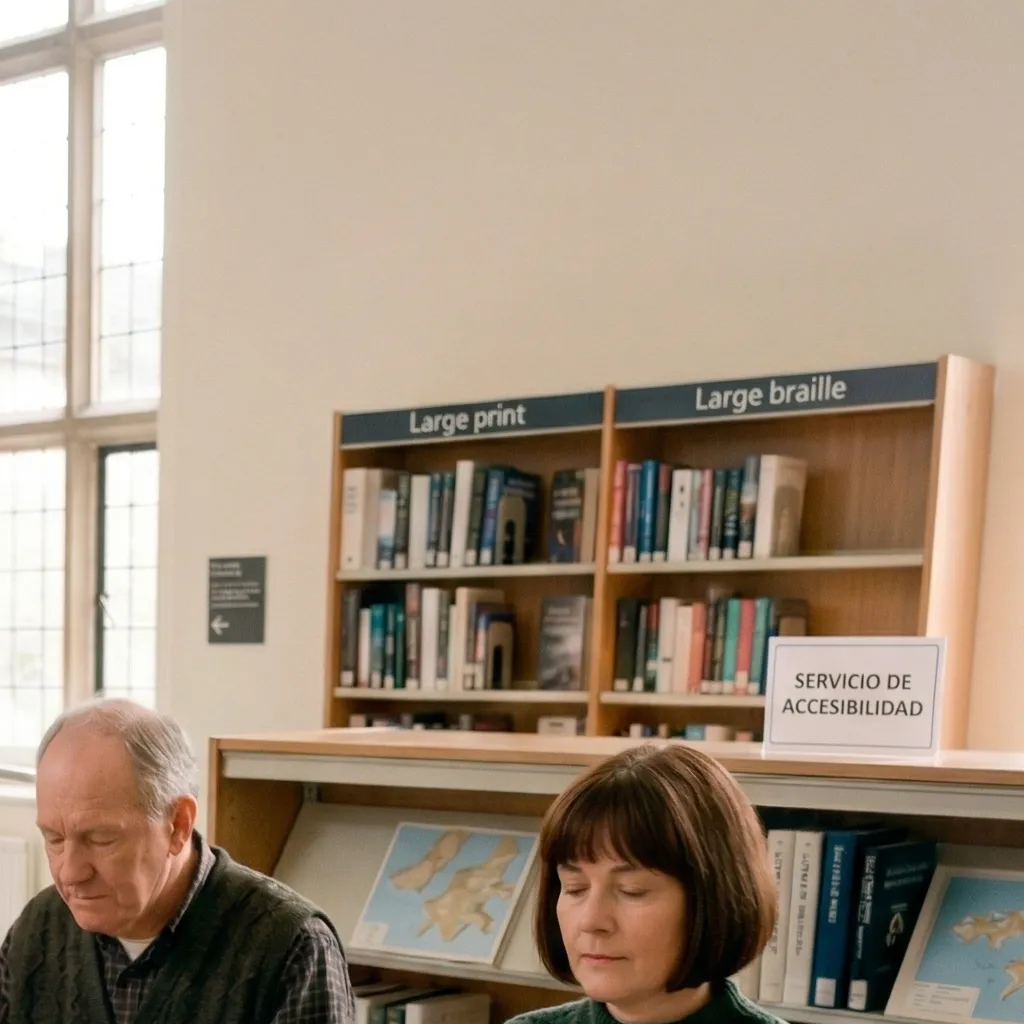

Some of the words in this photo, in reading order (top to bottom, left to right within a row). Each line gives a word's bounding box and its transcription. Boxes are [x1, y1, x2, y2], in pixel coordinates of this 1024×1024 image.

[695, 386, 764, 414] Large
[769, 374, 848, 405] braille
[409, 410, 470, 437] Large
[473, 402, 527, 434] print
[794, 672, 881, 690] SERVICIO
[887, 673, 912, 690] DE
[781, 698, 924, 717] ACCESIBILIDAD
